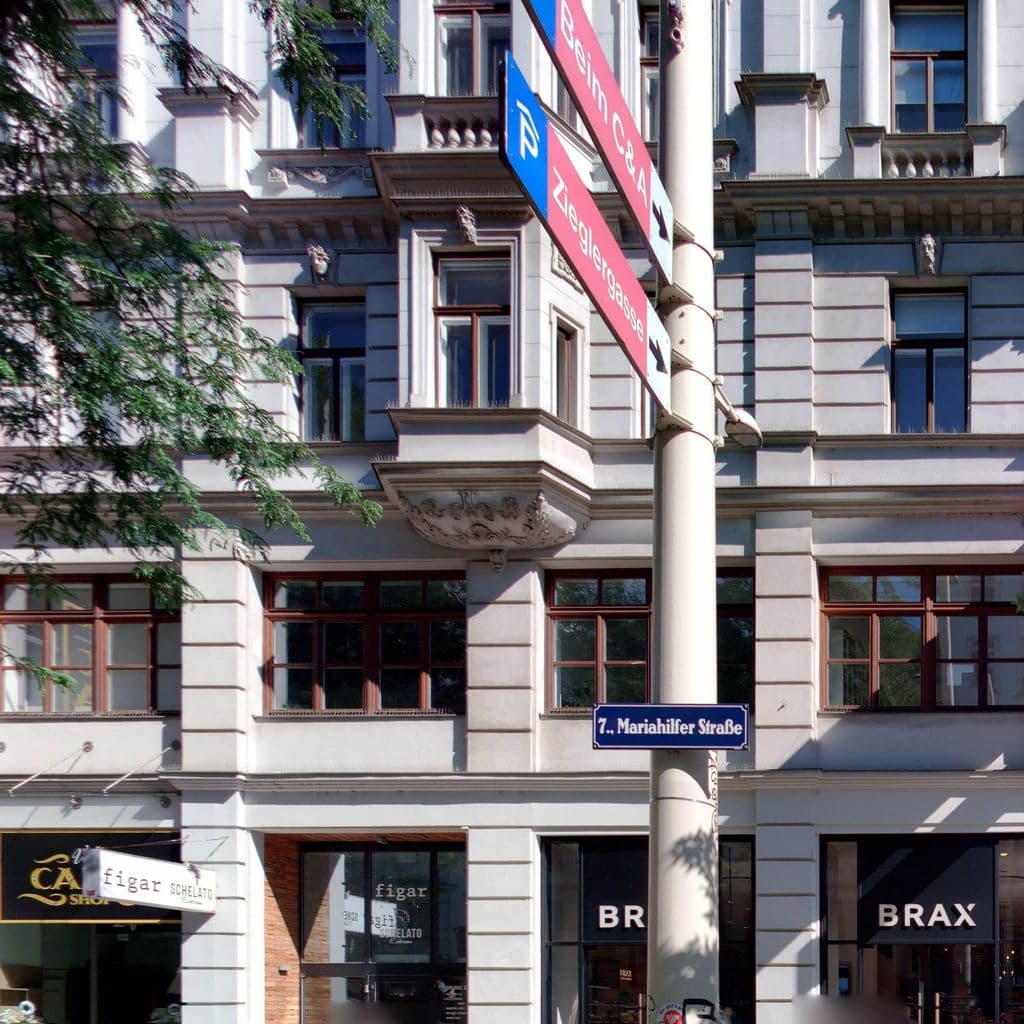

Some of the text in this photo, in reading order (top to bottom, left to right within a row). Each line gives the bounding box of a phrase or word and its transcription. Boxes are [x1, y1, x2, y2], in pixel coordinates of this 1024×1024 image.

[561, 0, 648, 207] Beim C&A
[552, 166, 645, 343] Zieglergasse
[617, 718, 695, 735] Mariahilfer
[698, 718, 743, 735] Straße
[30, 867, 83, 890] CA
[103, 867, 161, 893] figar
[169, 883, 214, 901] SCHELATO
[375, 884, 428, 901] figar
[598, 904, 646, 929] BR
[878, 903, 976, 927] BRAX
